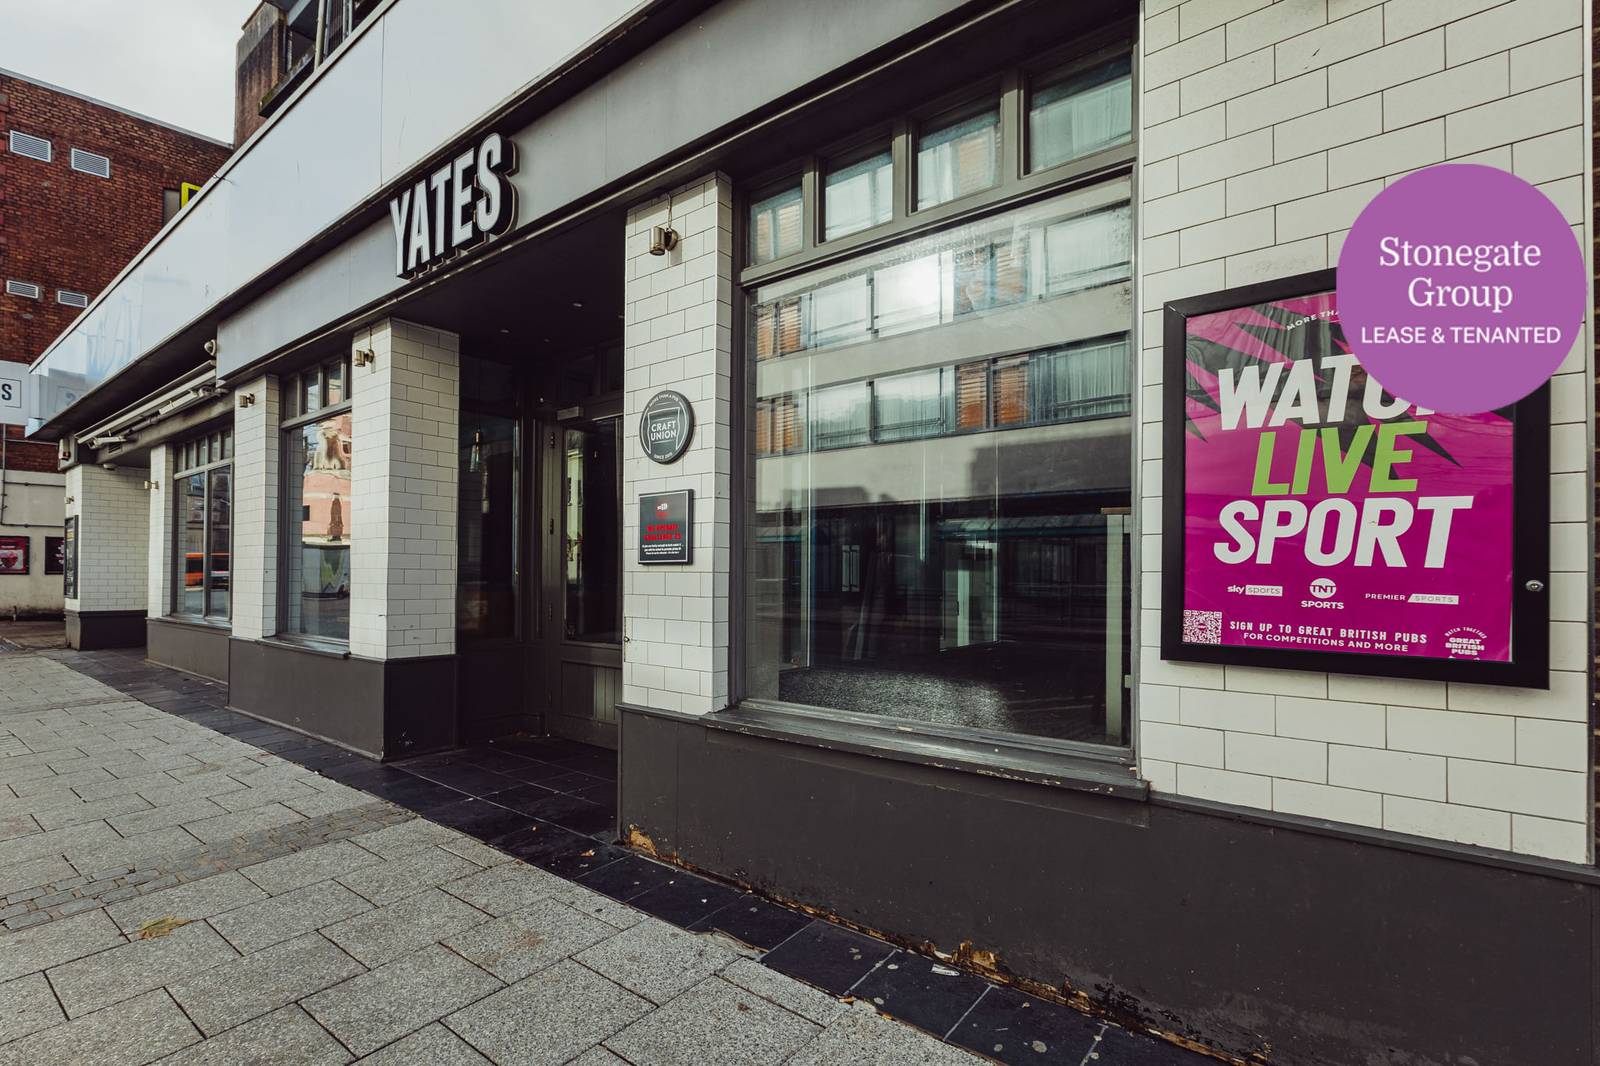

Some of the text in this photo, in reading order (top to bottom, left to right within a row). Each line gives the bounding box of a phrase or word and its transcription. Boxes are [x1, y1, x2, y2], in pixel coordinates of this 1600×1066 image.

[390, 132, 502, 277] YATES
[1286, 314, 1317, 331] MORE
[651, 420, 676, 432] CRAFT
[650, 429, 677, 441] UNION
[1251, 421, 1428, 496] LIVE
[1213, 496, 1474, 568] SPORT
[1227, 585, 1281, 595] sky sports
[1365, 593, 1456, 603] PREMIER SPORTS
[1301, 600, 1344, 610] SPORTS
[1229, 621, 1427, 644] SIGN UP TO GREAT BRITISH PUBS
[1243, 632, 1408, 652] FOR COMPETITIONS AND MORE
[1445, 642, 1485, 651] BRITISH
[1449, 637, 1481, 645] GREAT
[1451, 648, 1478, 656] PUBS
